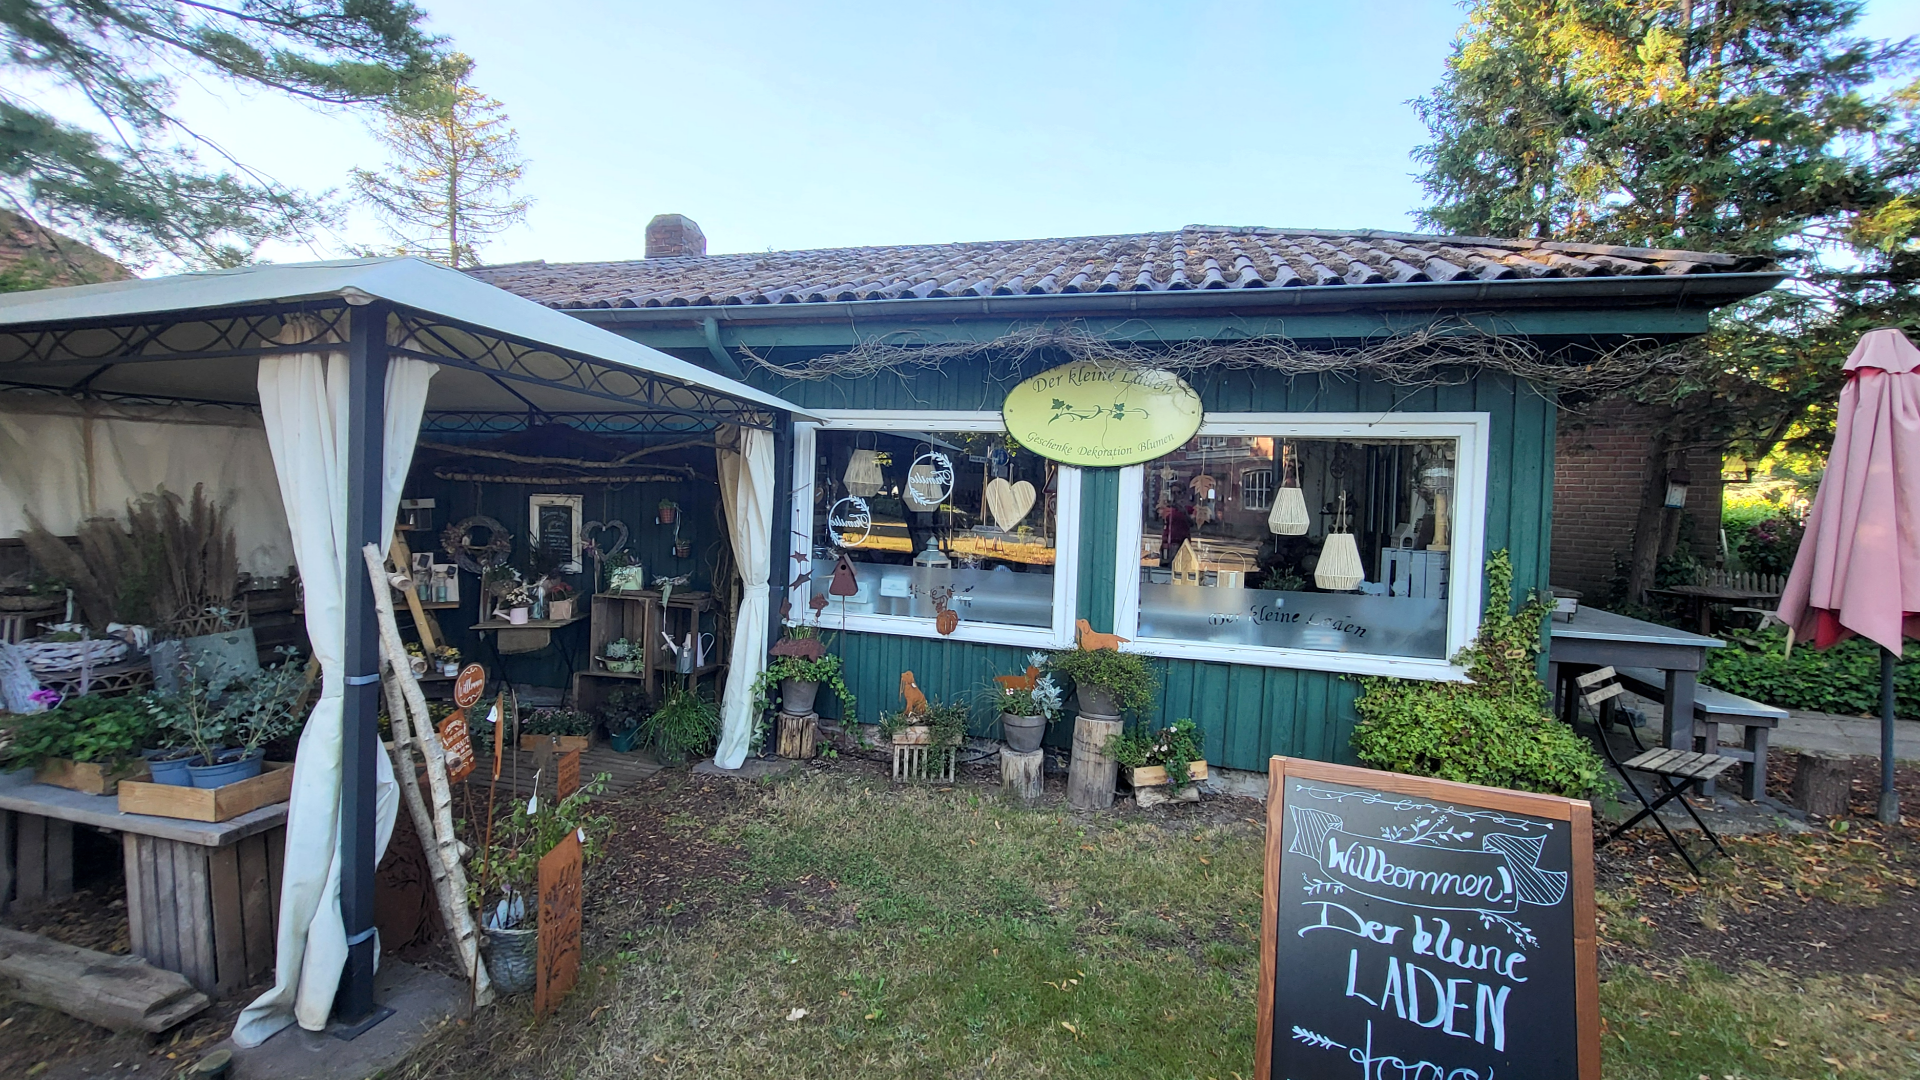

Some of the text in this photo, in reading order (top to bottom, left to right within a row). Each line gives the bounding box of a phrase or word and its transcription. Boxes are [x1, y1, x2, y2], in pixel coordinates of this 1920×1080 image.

[1033, 366, 1173, 394] Der kleine Laden
[1026, 431, 1175, 459] Geschenke Dekoration Blumen
[1208, 604, 1367, 638] Der kleine Laden
[1328, 837, 1513, 904] Willkommen!
[1297, 901, 1528, 983] Der kleine
[1345, 948, 1512, 1052] LADEN
